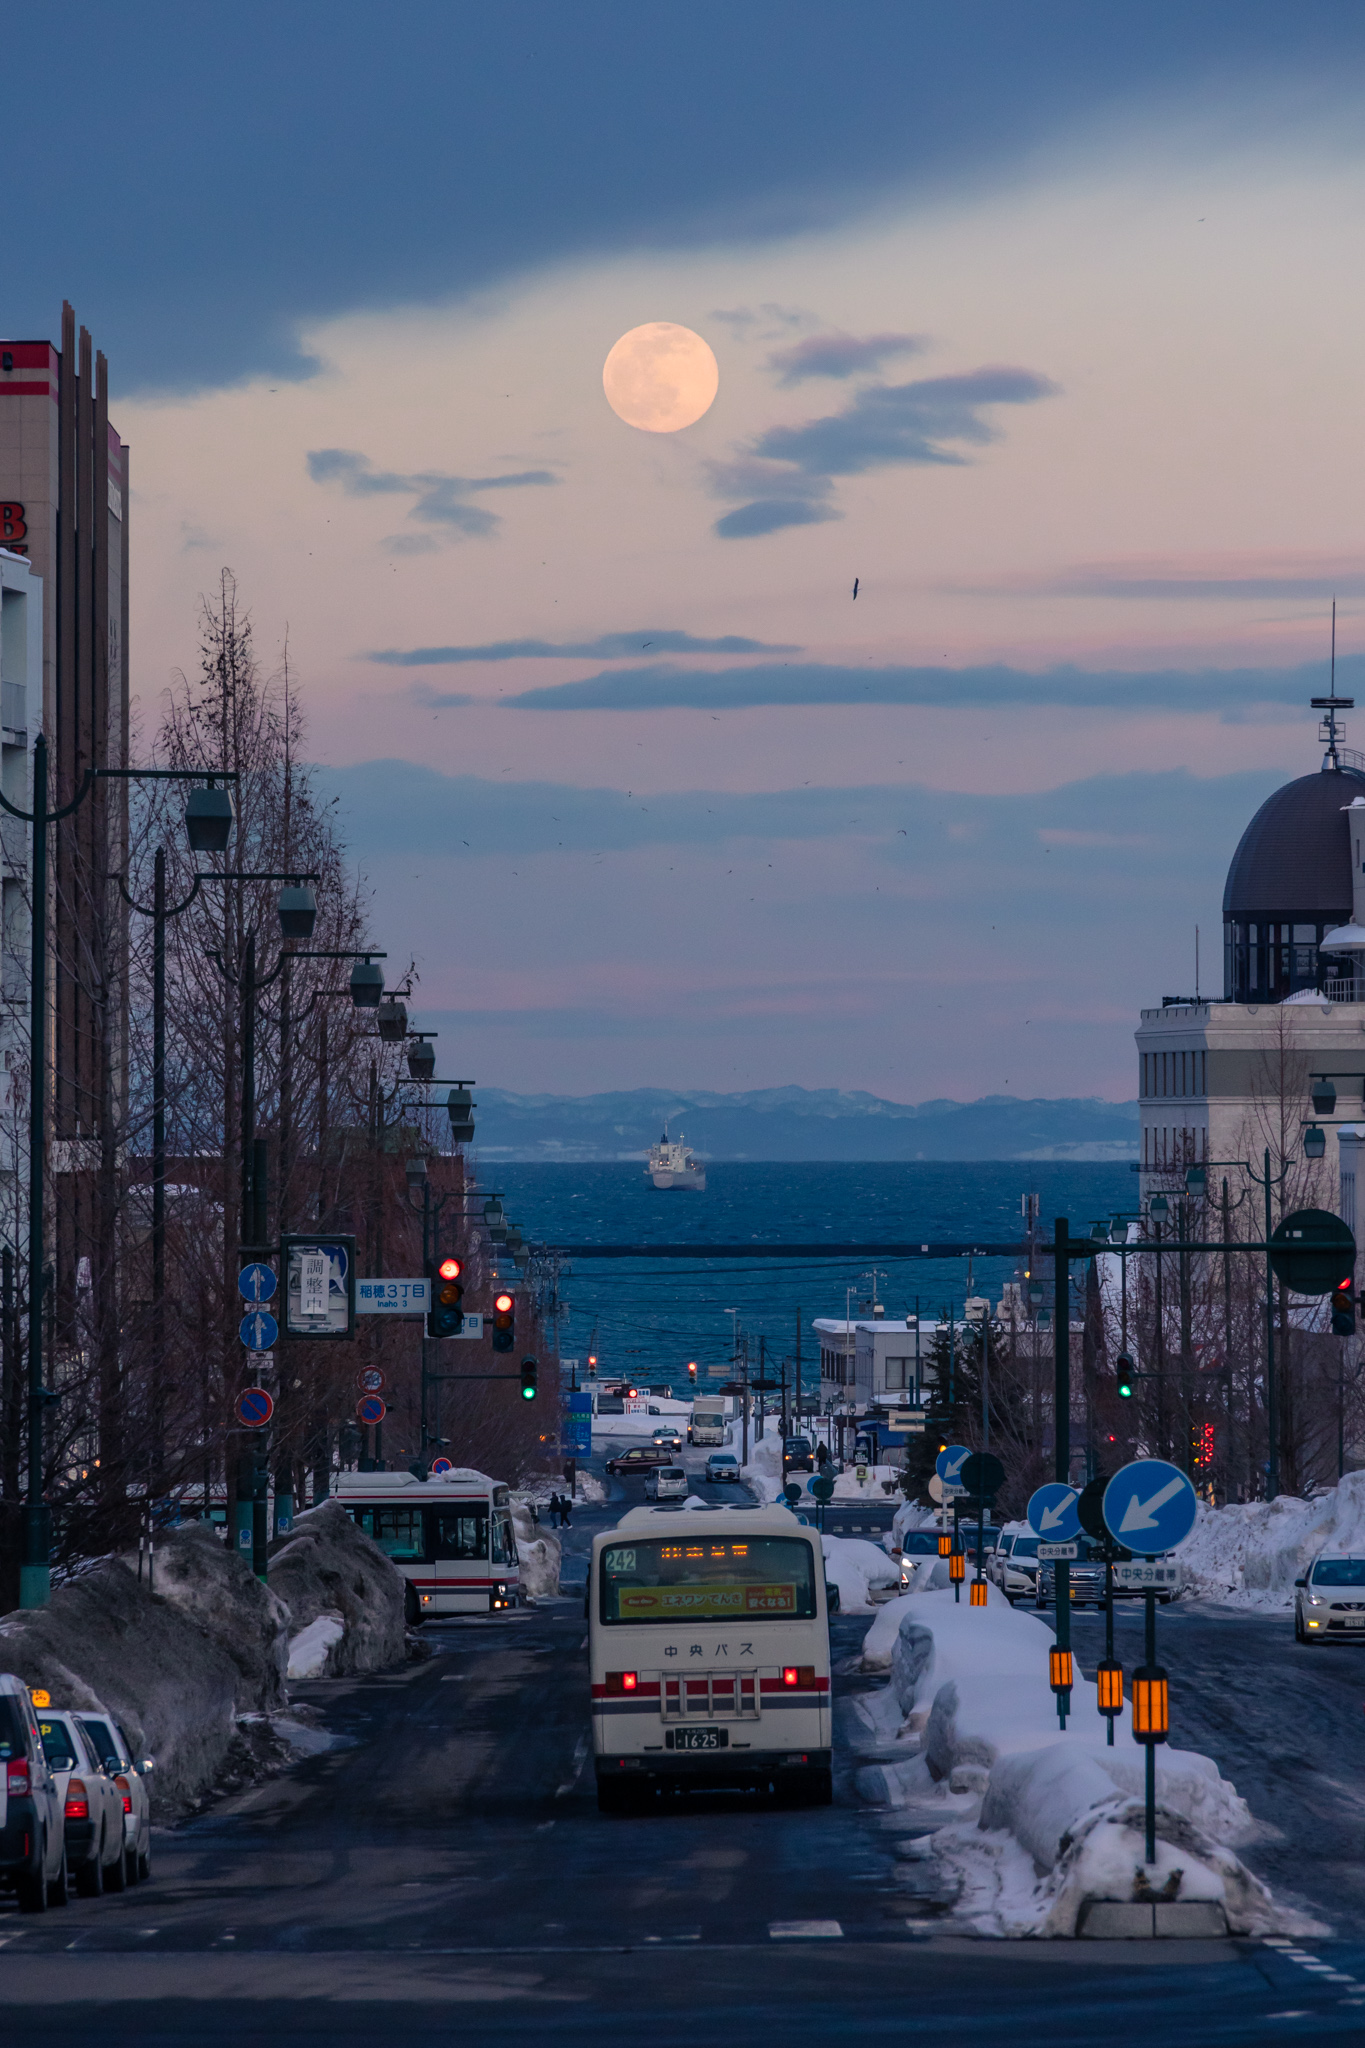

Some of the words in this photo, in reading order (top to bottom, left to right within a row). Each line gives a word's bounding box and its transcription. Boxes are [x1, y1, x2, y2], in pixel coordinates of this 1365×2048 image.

[306, 1258, 324, 1314] 調整中
[359, 1284, 425, 1298] 稲穂3丁目
[377, 1300, 398, 1308] Inaho
[402, 1300, 408, 1308] 3
[1039, 1546, 1074, 1556] 中央分離帯
[605, 1550, 636, 1571] 242
[1121, 1567, 1177, 1582] 中央分離帯
[664, 1642, 754, 1658] 中央バス
